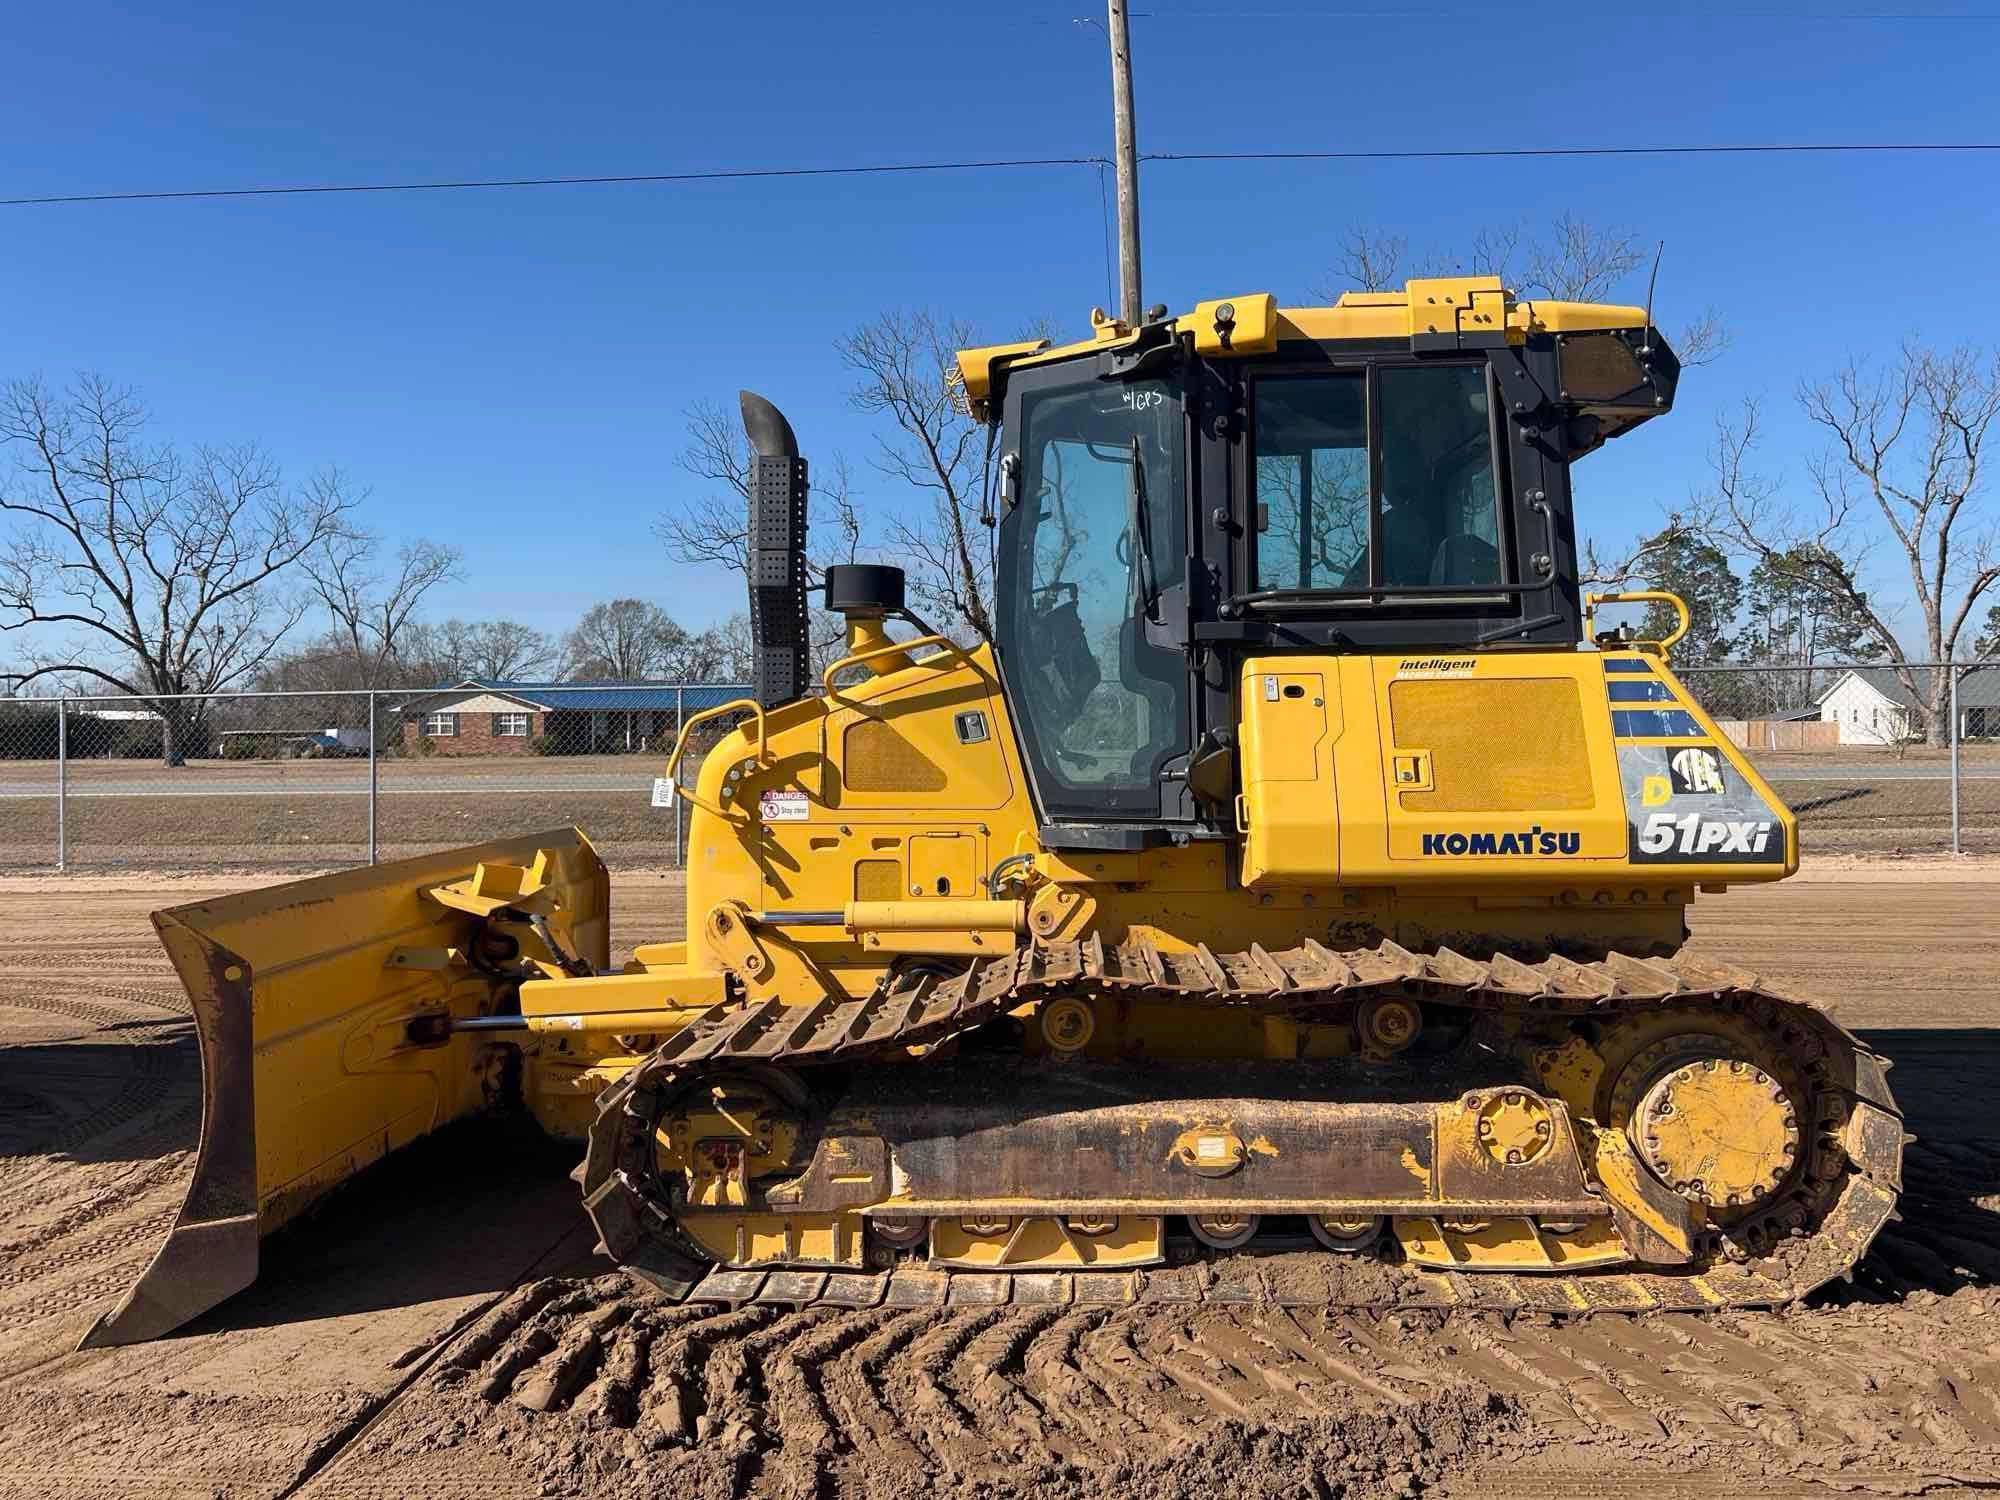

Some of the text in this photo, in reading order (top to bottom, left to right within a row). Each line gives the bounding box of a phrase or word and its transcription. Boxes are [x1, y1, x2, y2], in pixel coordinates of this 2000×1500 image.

[1400, 660, 1476, 671] intelligent
[772, 791, 808, 800] DANGER
[1423, 826, 1580, 855] KOMATSU
[1638, 813, 1771, 855] 51PXi
